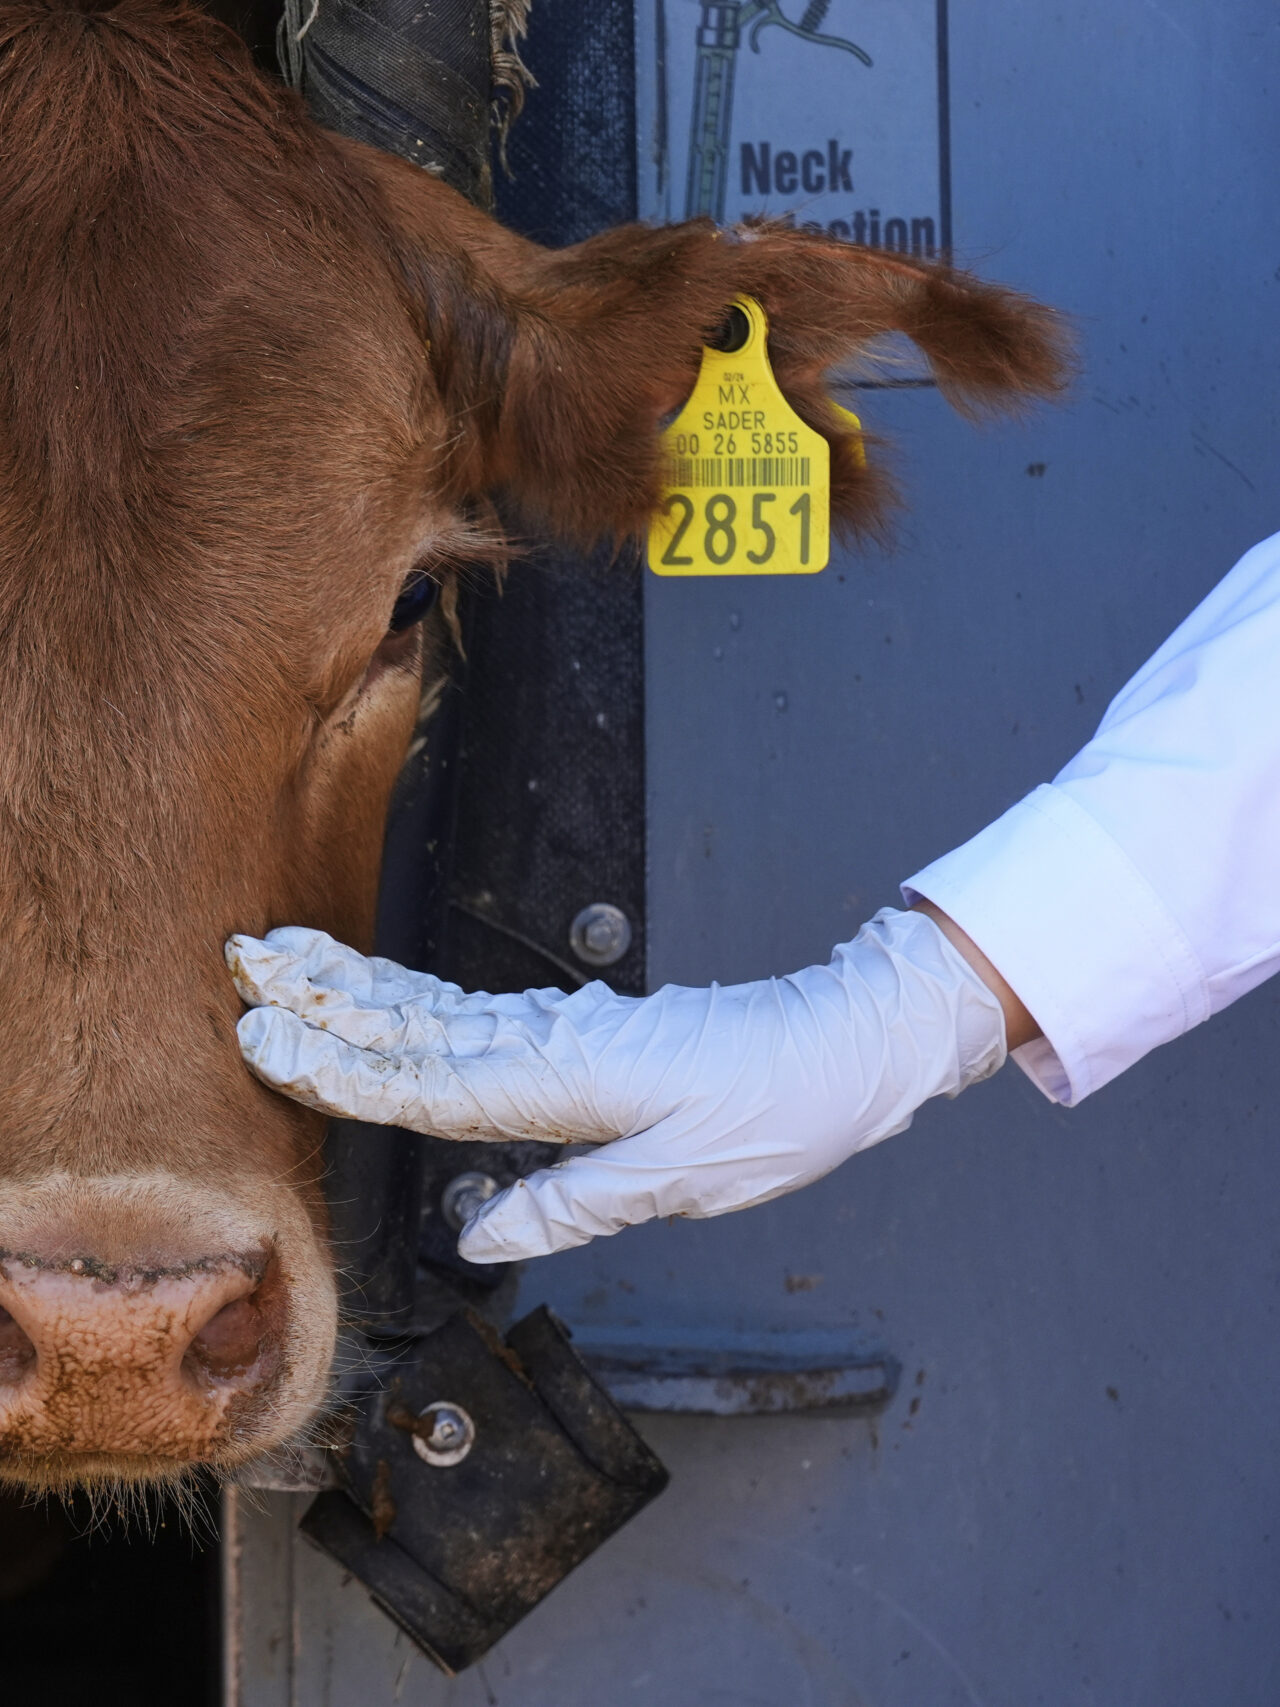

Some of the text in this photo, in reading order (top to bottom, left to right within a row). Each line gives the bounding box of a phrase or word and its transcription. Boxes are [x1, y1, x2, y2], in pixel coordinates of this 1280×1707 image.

[740, 139, 854, 196] Neck
[718, 384, 751, 405] MX
[703, 411, 766, 430] SADER
[676, 431, 798, 455] 00 26 5855
[661, 493, 811, 566] 2851
